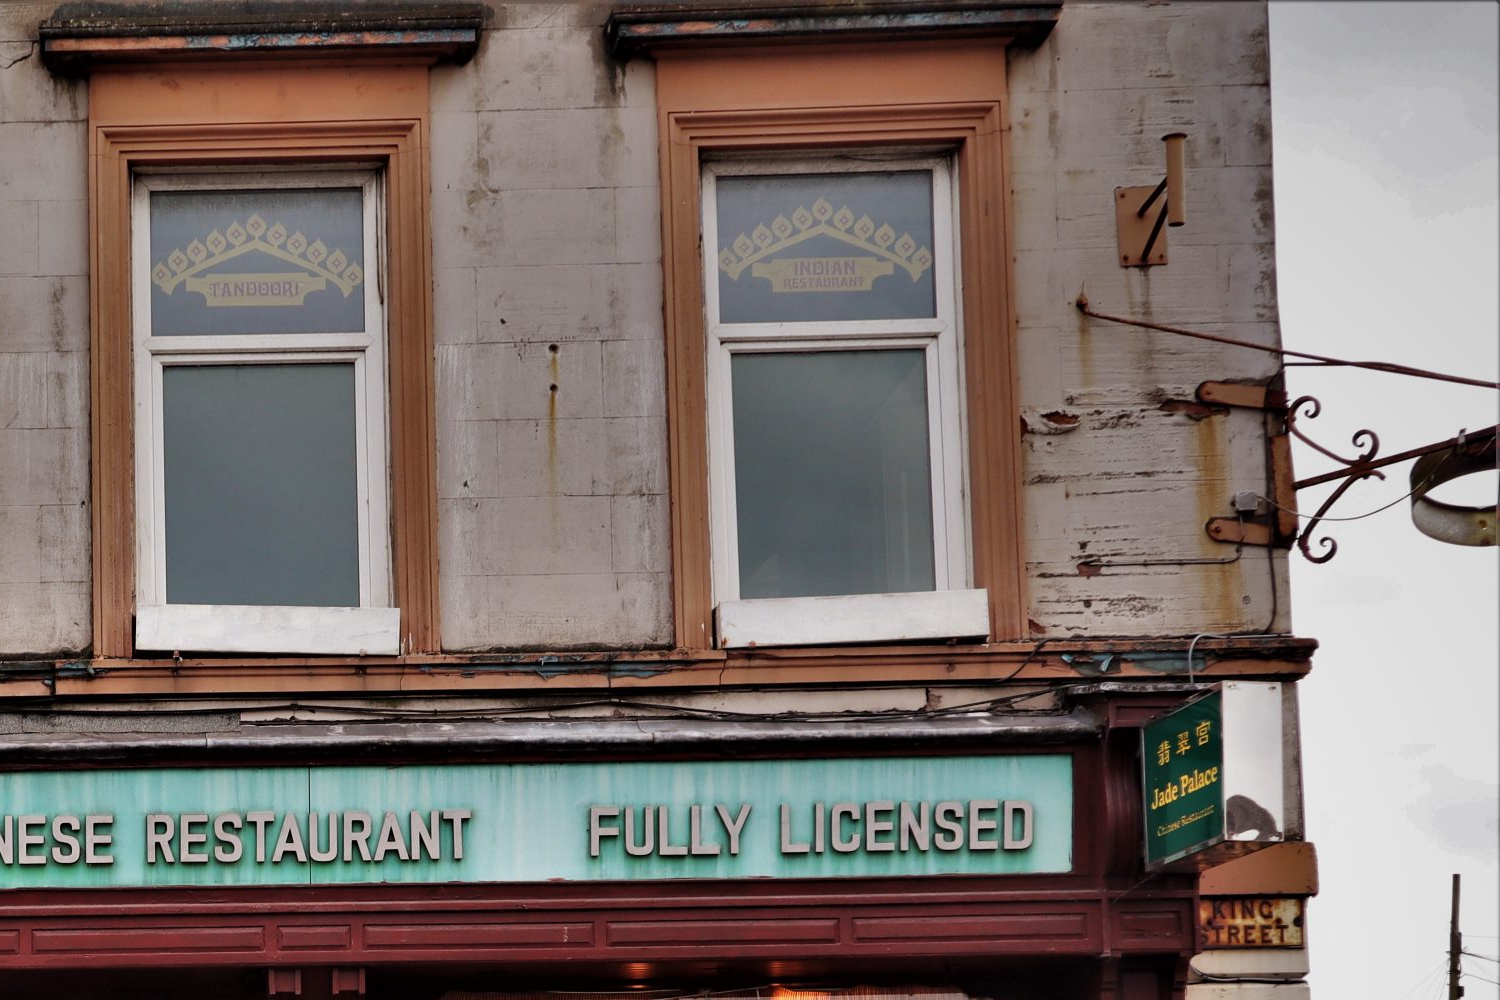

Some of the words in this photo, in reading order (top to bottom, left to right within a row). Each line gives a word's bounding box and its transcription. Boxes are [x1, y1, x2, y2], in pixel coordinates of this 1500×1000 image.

[793, 260, 856, 276] INDIAN
[208, 281, 300, 297] TANDOORI
[783, 276, 865, 289] RESTAURANT
[1151, 782, 1179, 810] Jade
[1180, 766, 1219, 797] Palace
[146, 809, 473, 864] RESTAURANT
[588, 803, 752, 858] FULLY
[779, 799, 1036, 855] LICENSED
[1212, 900, 1274, 919] KING
